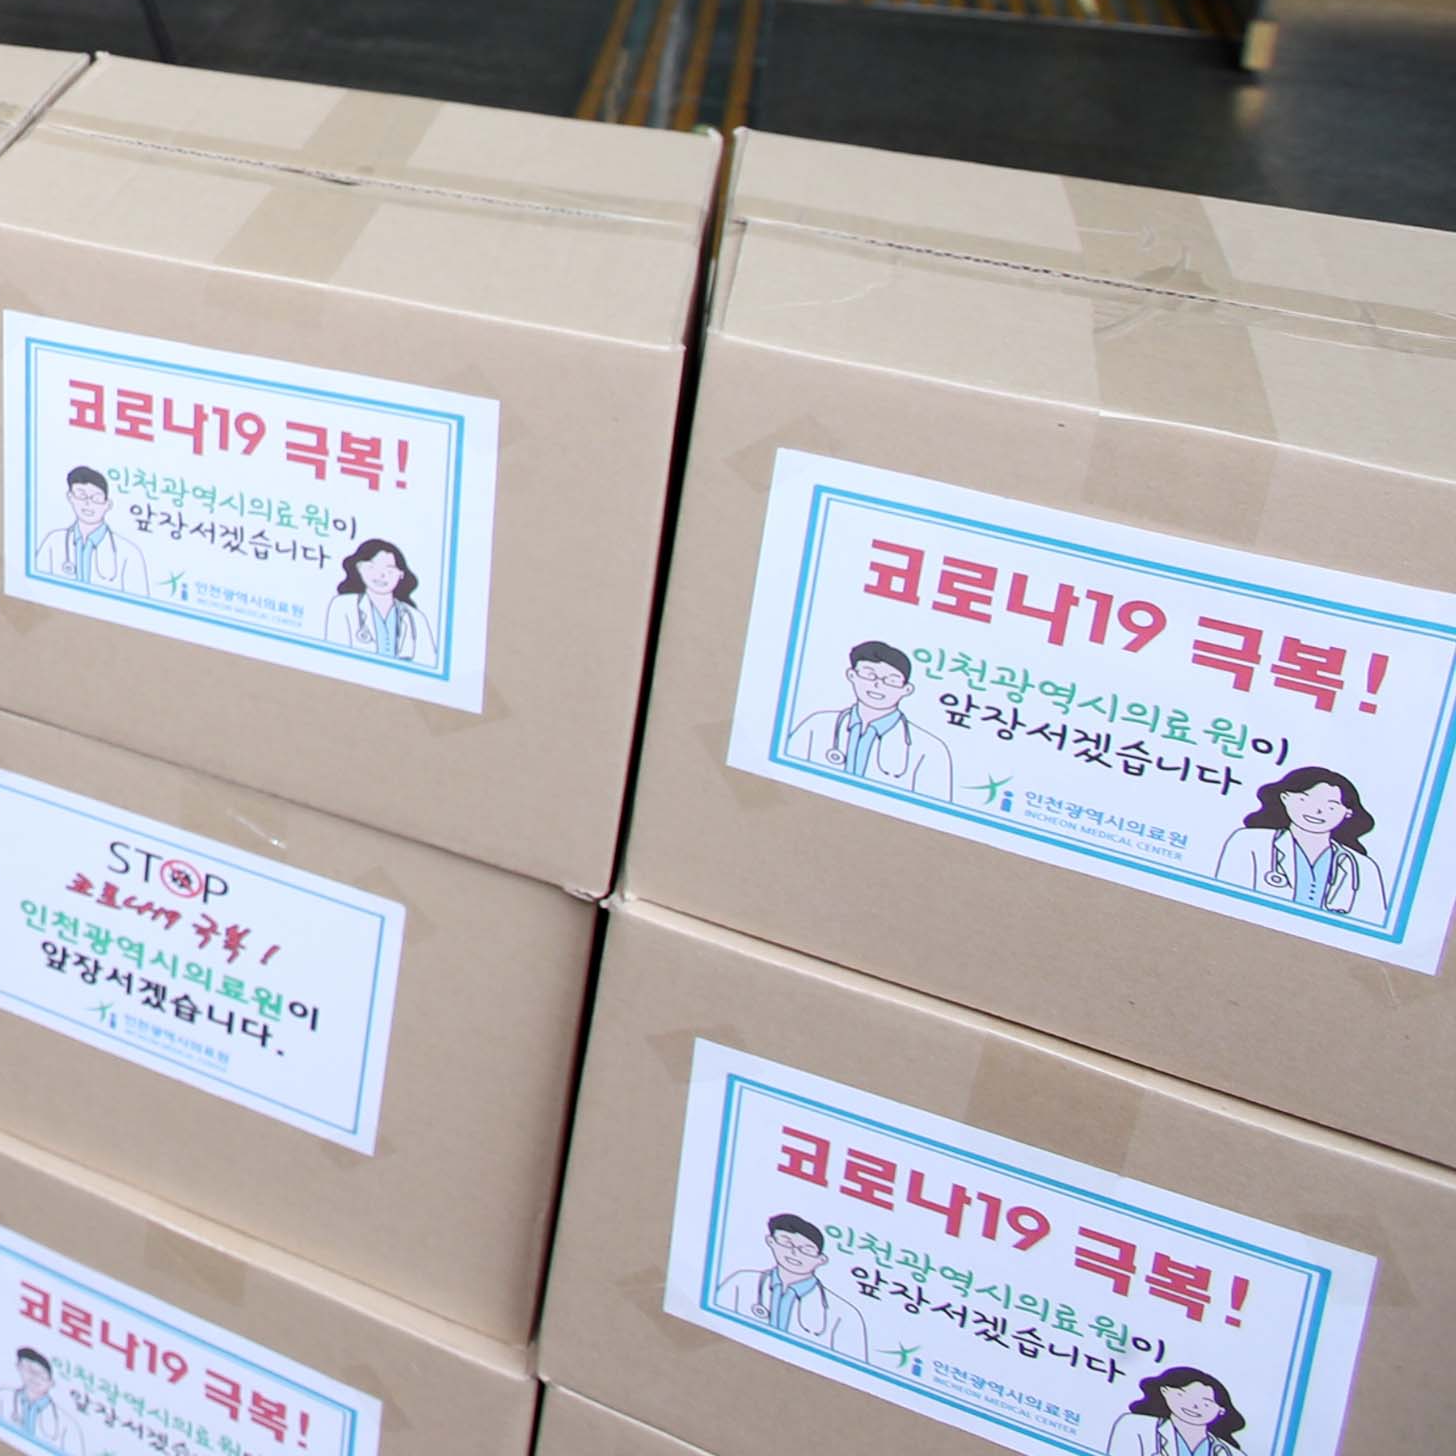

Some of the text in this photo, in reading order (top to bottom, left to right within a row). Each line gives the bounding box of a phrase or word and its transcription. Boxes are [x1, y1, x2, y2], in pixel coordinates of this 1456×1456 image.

[68, 378, 409, 491] 코로나19 극복!
[106, 466, 357, 540] 인천광역시의료원이
[129, 503, 332, 569] 앞장서겠습니다
[863, 538, 1391, 715] 코로나19 극복!
[912, 646, 1290, 766] 인천광역시의료원이
[939, 690, 1243, 796] 앞장서겠습니다
[107, 841, 230, 904] STOP
[1024, 809, 1184, 862] INCHEON MEDICAL CENTER
[1025, 790, 1189, 850] 인천광역시의료원
[20, 899, 320, 1032] 인천광역시의료원이
[41, 940, 287, 1058] 앞장서겠습니다.
[776, 1125, 1250, 1328] 코로나19 극복!
[823, 1222, 1165, 1364] 인천광역시의료원이
[849, 1266, 1127, 1384] 앞장서겠습니다
[19, 1280, 312, 1451] 코로나19 극복!
[932, 1359, 1081, 1426] 인천광역시의료원
[1035, 1413, 1078, 1435] CENTER
